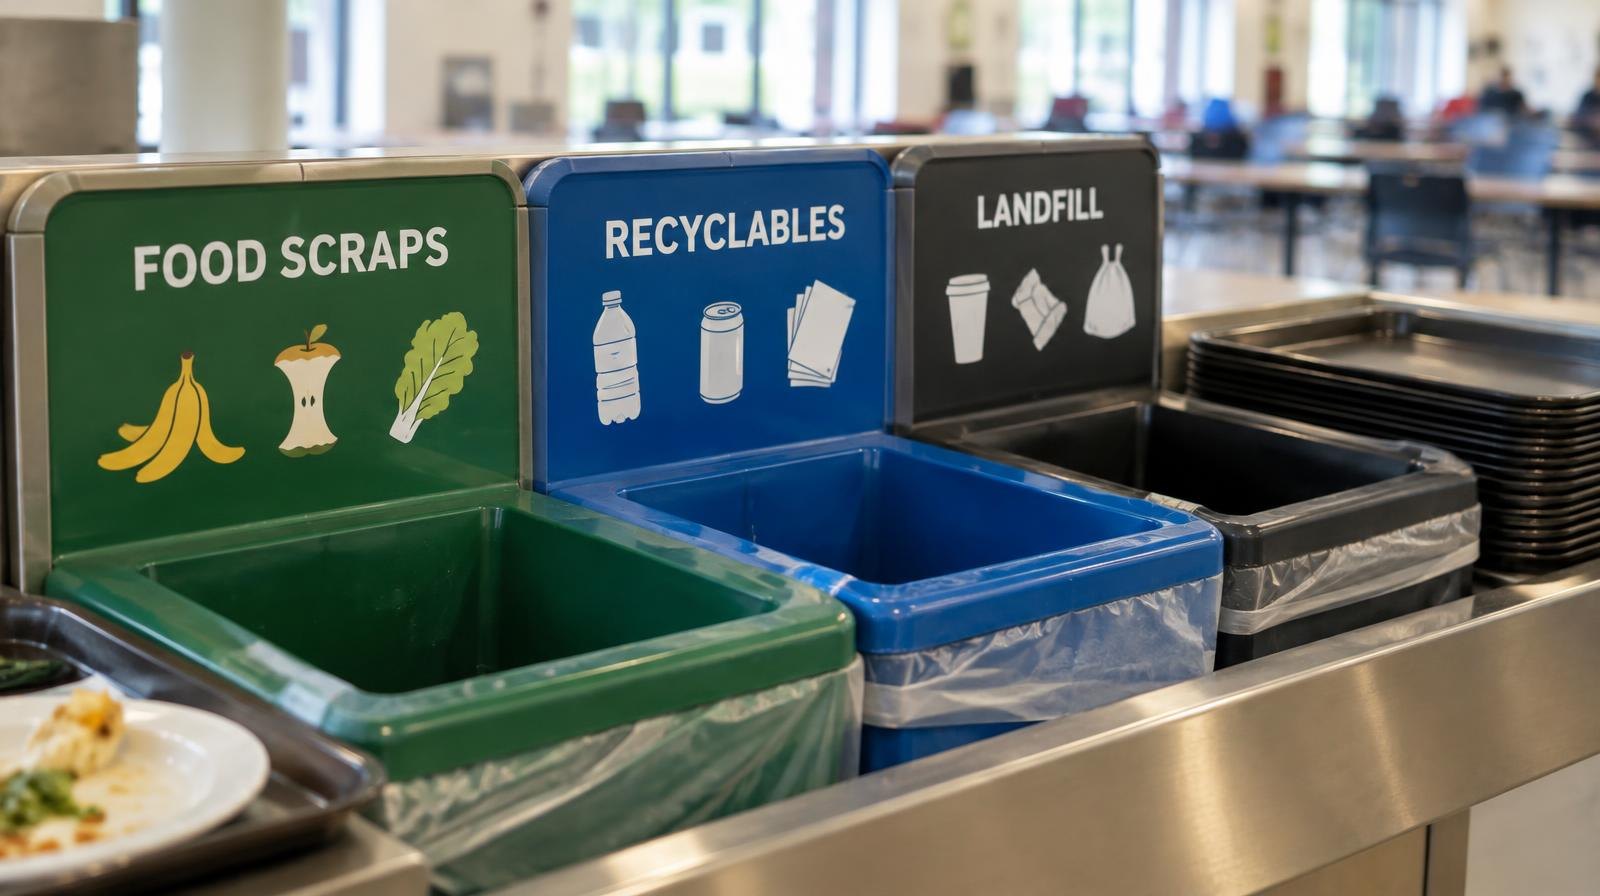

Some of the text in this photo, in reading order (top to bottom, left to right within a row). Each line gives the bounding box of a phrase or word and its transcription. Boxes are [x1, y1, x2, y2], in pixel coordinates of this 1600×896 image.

[605, 204, 846, 259] RECYCLABLES
[977, 187, 1104, 229] LANDFILL
[134, 226, 449, 291] FOOD SCRAPS
